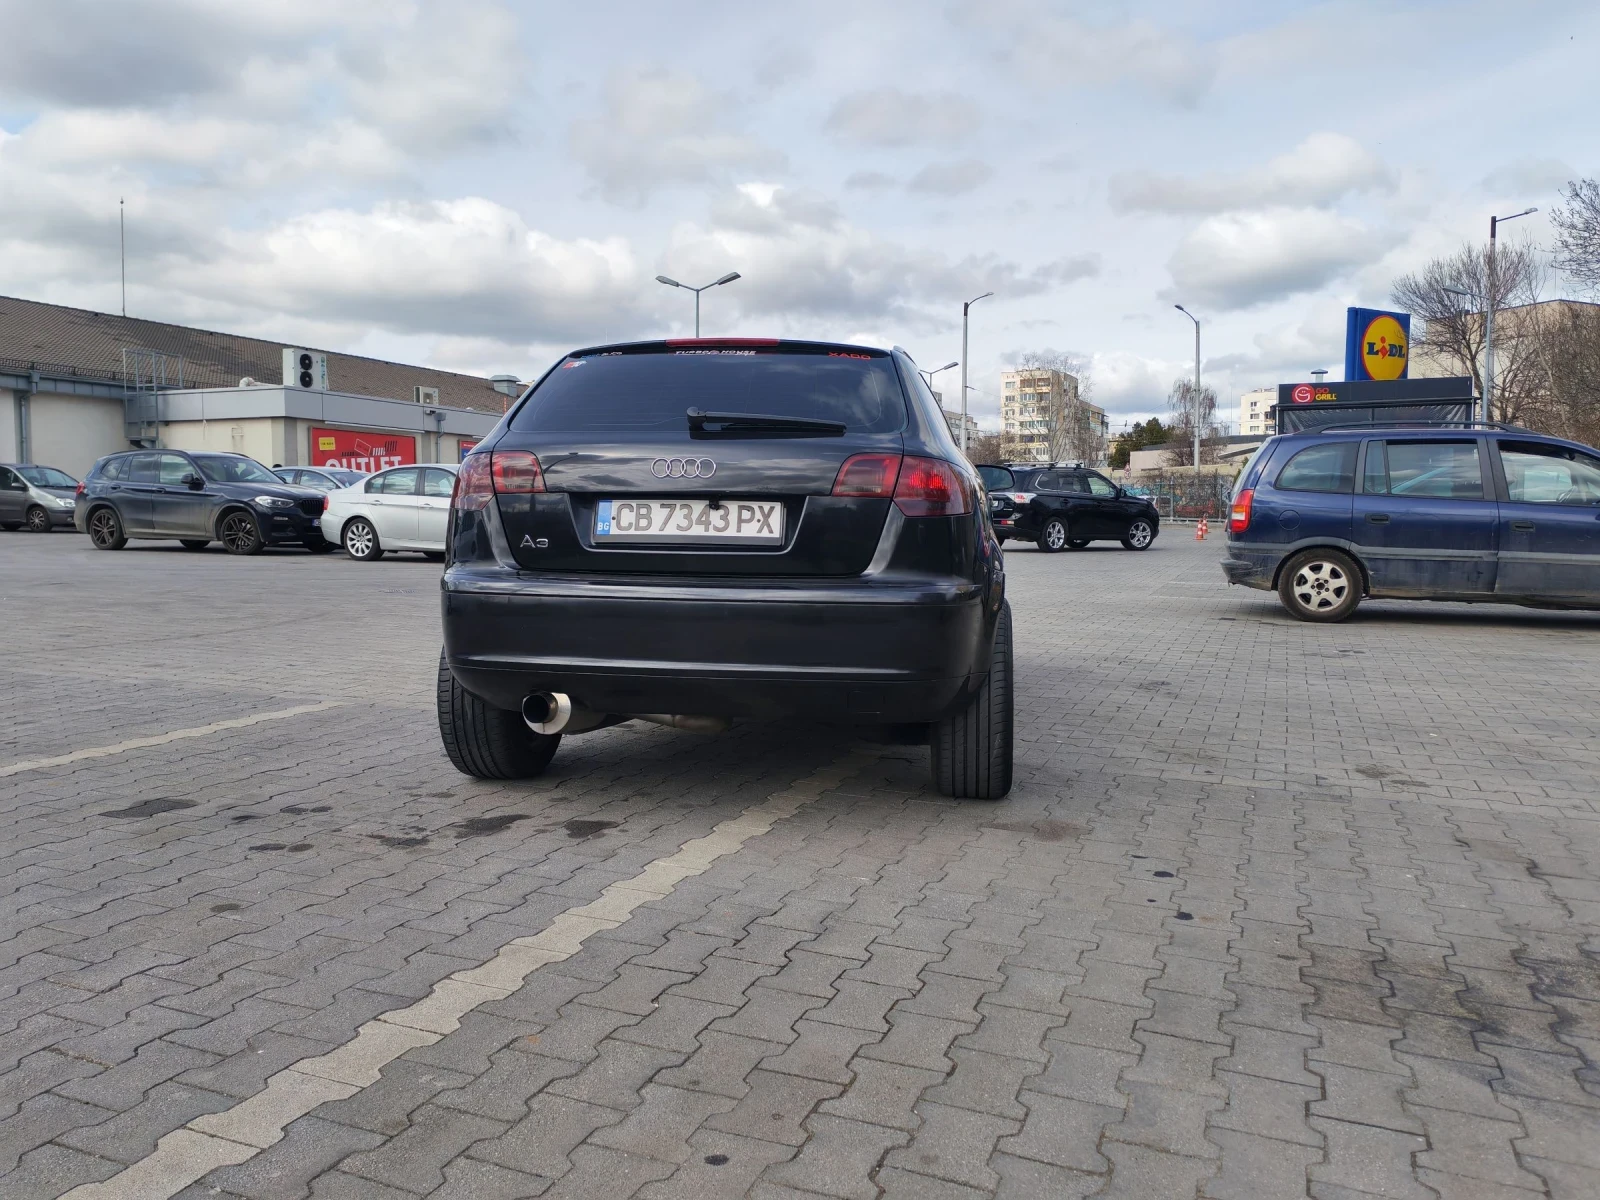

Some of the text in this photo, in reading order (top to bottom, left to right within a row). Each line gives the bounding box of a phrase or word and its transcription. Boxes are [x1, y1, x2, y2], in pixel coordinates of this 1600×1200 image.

[828, 352, 871, 361] XADO
[1315, 393, 1337, 401] GRILL
[615, 503, 776, 534] CB 7343 PX
[597, 522, 610, 531] BG
[519, 534, 549, 549] A3
